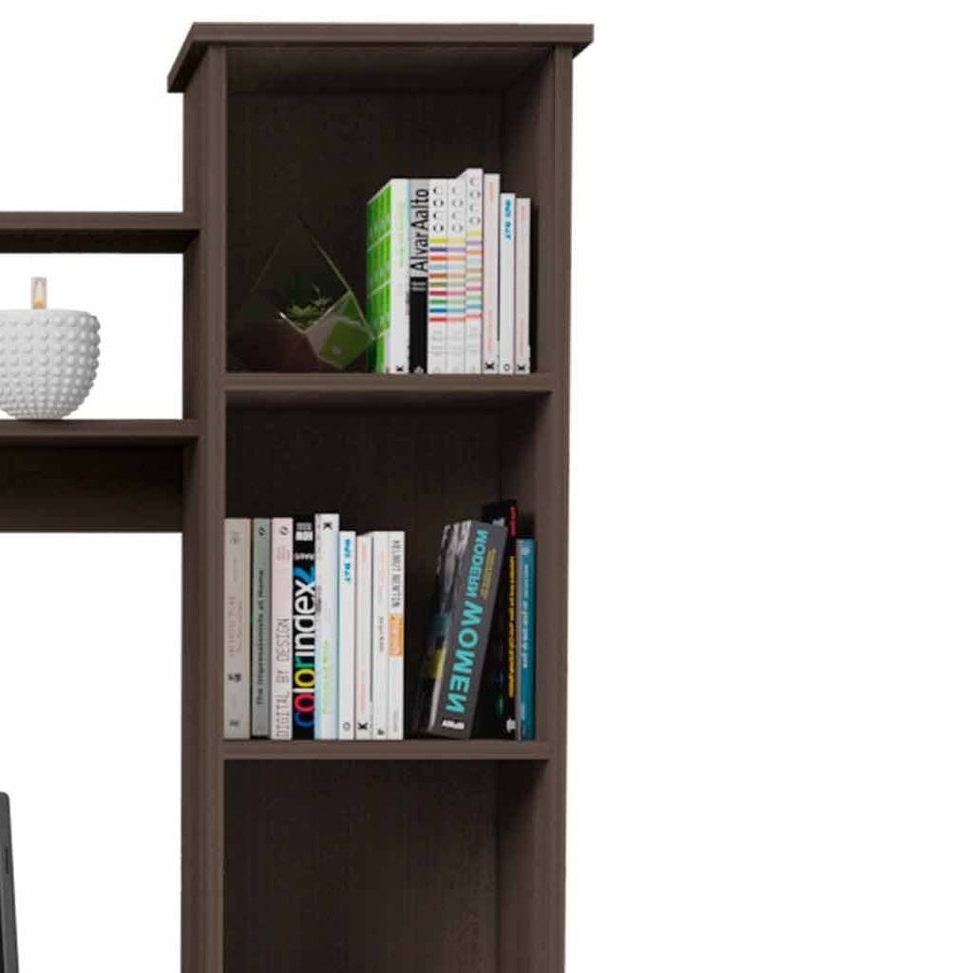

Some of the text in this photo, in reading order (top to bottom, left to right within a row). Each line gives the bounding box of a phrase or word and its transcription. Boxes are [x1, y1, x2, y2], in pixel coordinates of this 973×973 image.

[276, 618, 290, 738] DIGITAL BY DESIGN
